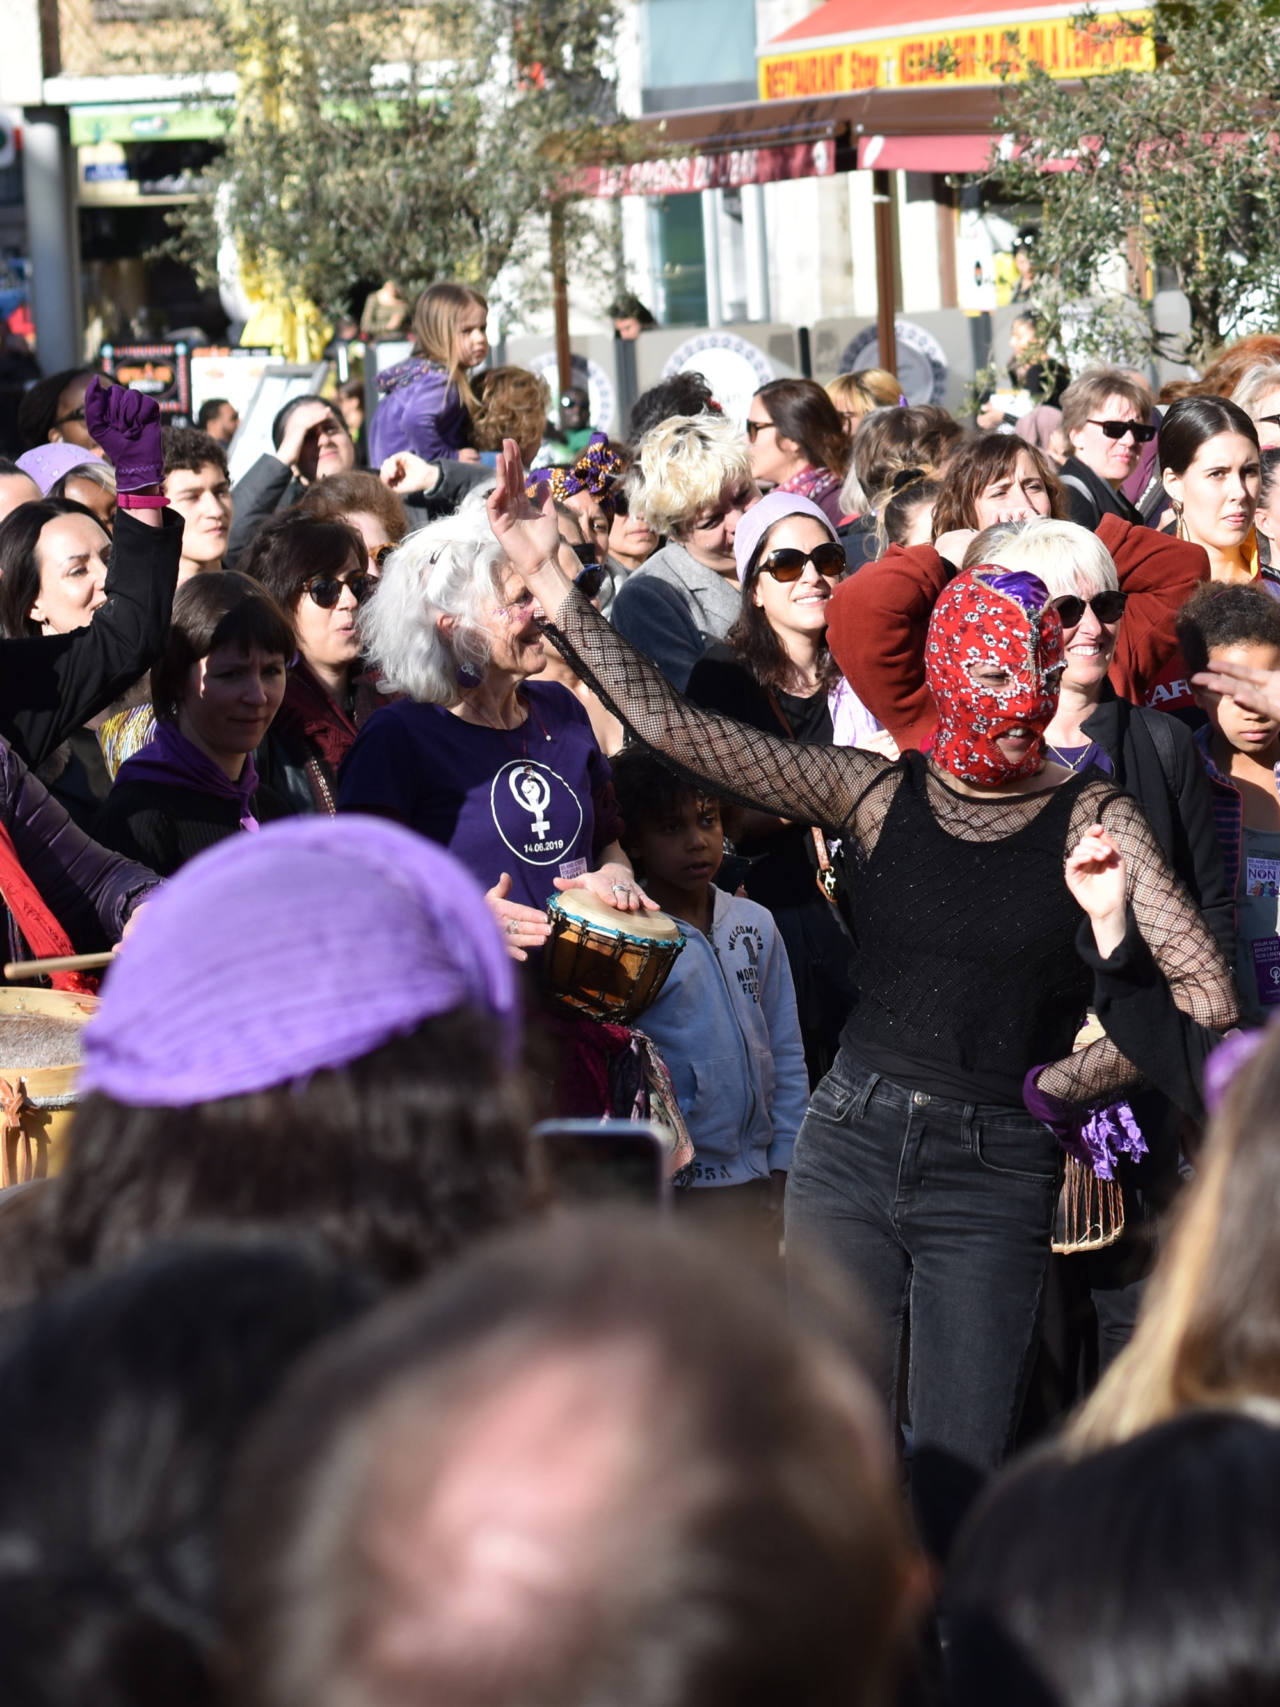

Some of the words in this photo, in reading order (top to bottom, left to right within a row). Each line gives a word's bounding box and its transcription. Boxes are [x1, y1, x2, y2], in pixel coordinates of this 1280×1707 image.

[766, 52, 843, 100] RESTAURANT
[523, 839, 564, 853] 14.06.2019
[1248, 869, 1276, 880] NON
